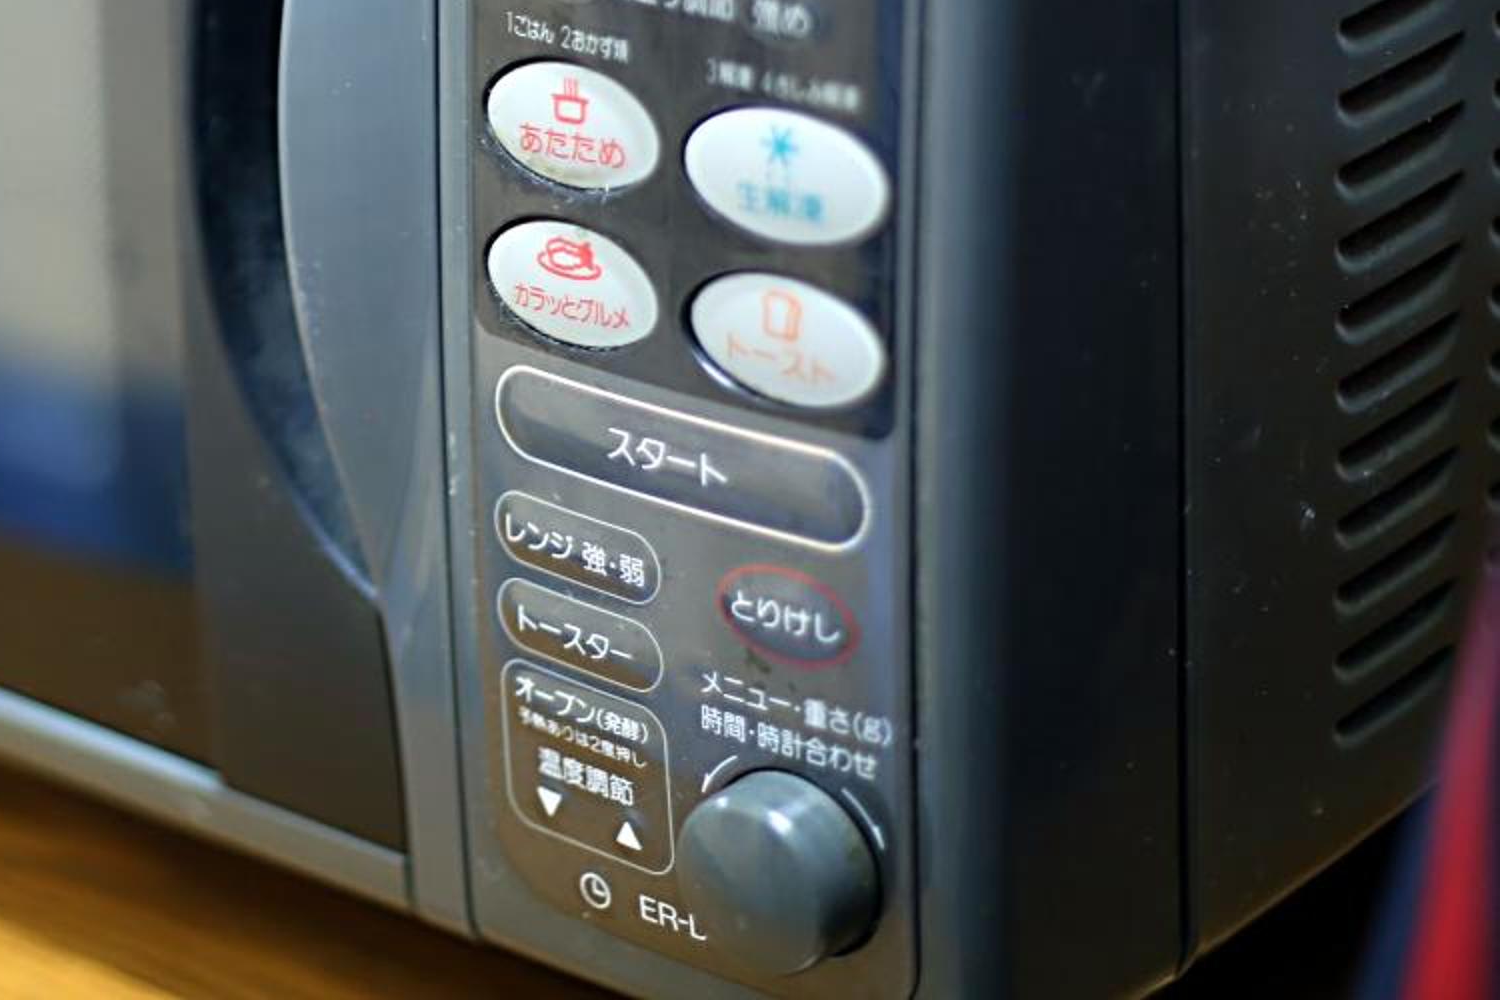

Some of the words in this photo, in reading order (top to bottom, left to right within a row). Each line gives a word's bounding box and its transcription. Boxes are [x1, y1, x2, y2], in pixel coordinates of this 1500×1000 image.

[518, 120, 626, 170] あたため
[513, 281, 630, 331] カラッとグルメ
[726, 331, 836, 386] トースト
[605, 427, 728, 487] スタート
[504, 512, 574, 560] レンジ
[514, 603, 634, 661] トースター
[731, 590, 842, 646] とりけし
[537, 746, 634, 807] 温度調節
